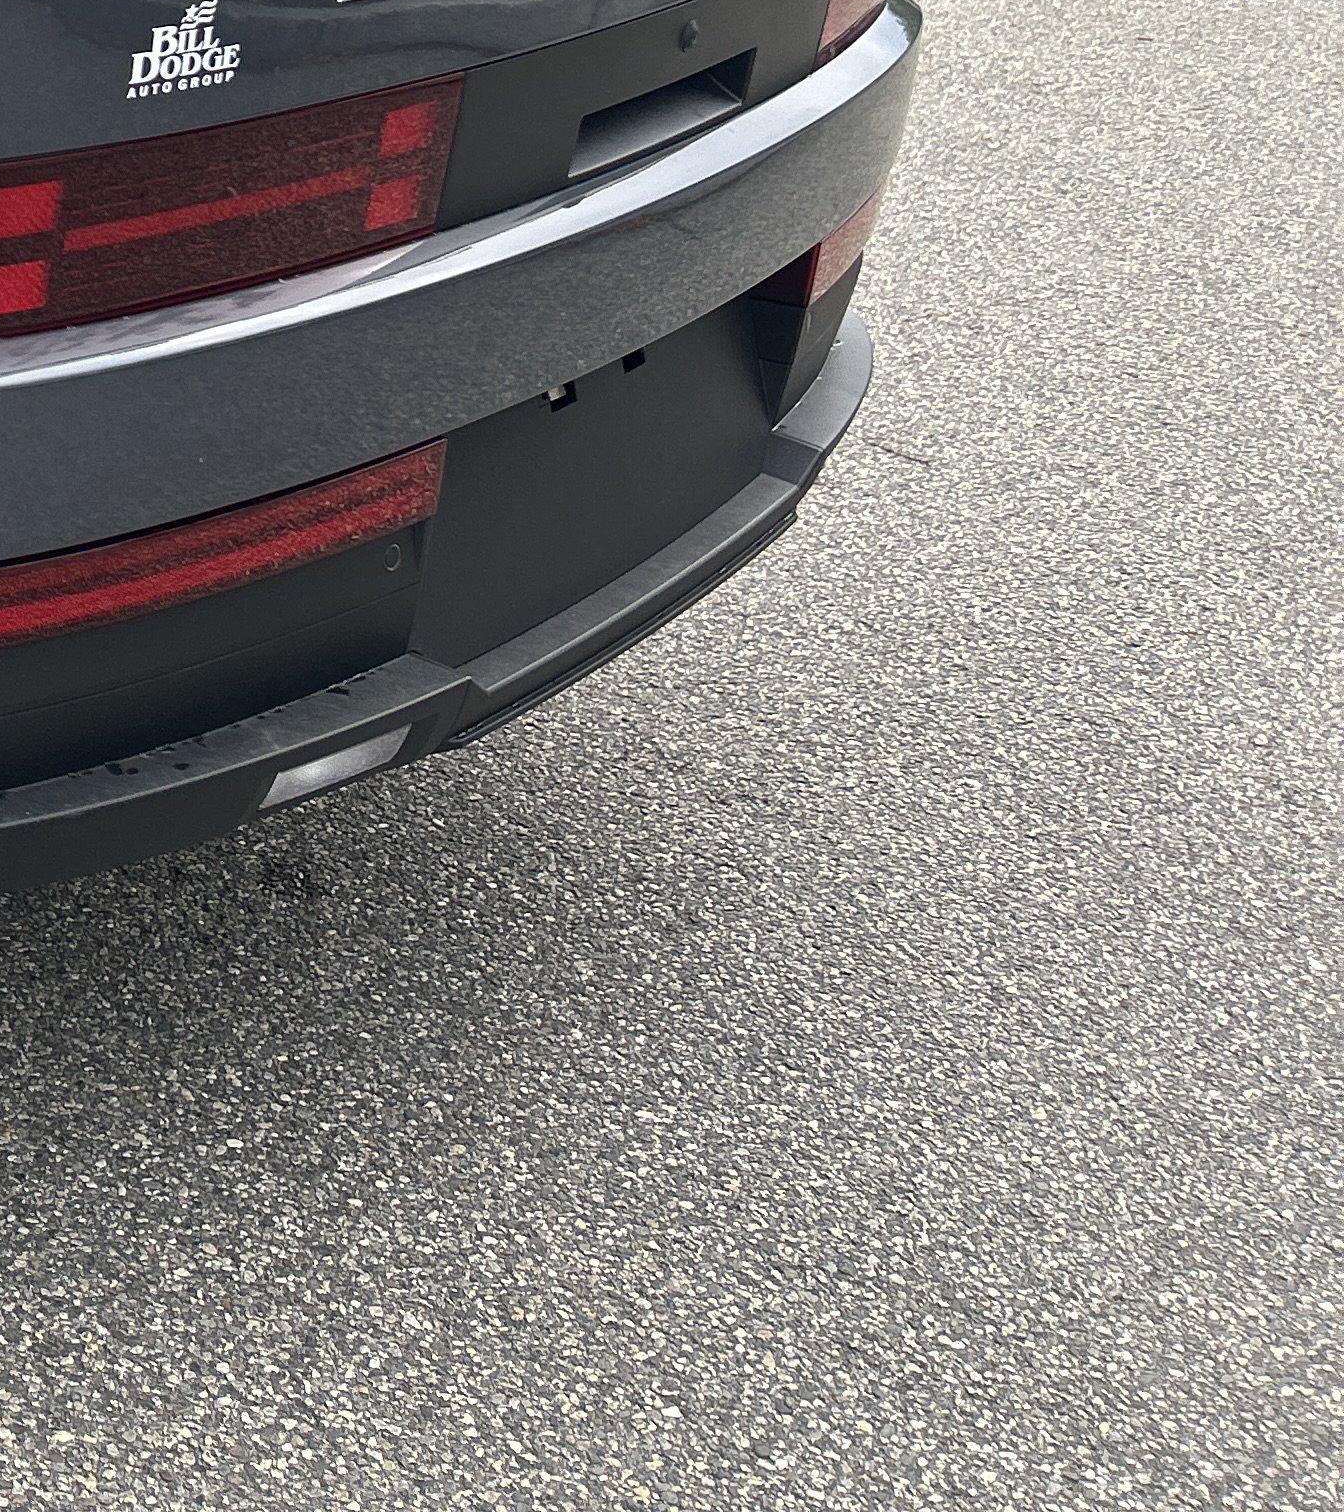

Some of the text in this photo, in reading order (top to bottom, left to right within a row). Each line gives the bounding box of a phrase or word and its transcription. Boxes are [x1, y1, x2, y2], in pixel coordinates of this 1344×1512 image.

[152, 25, 221, 58] BILL
[128, 43, 241, 85] DODGE
[126, 70, 235, 99] AUTO GROUP
